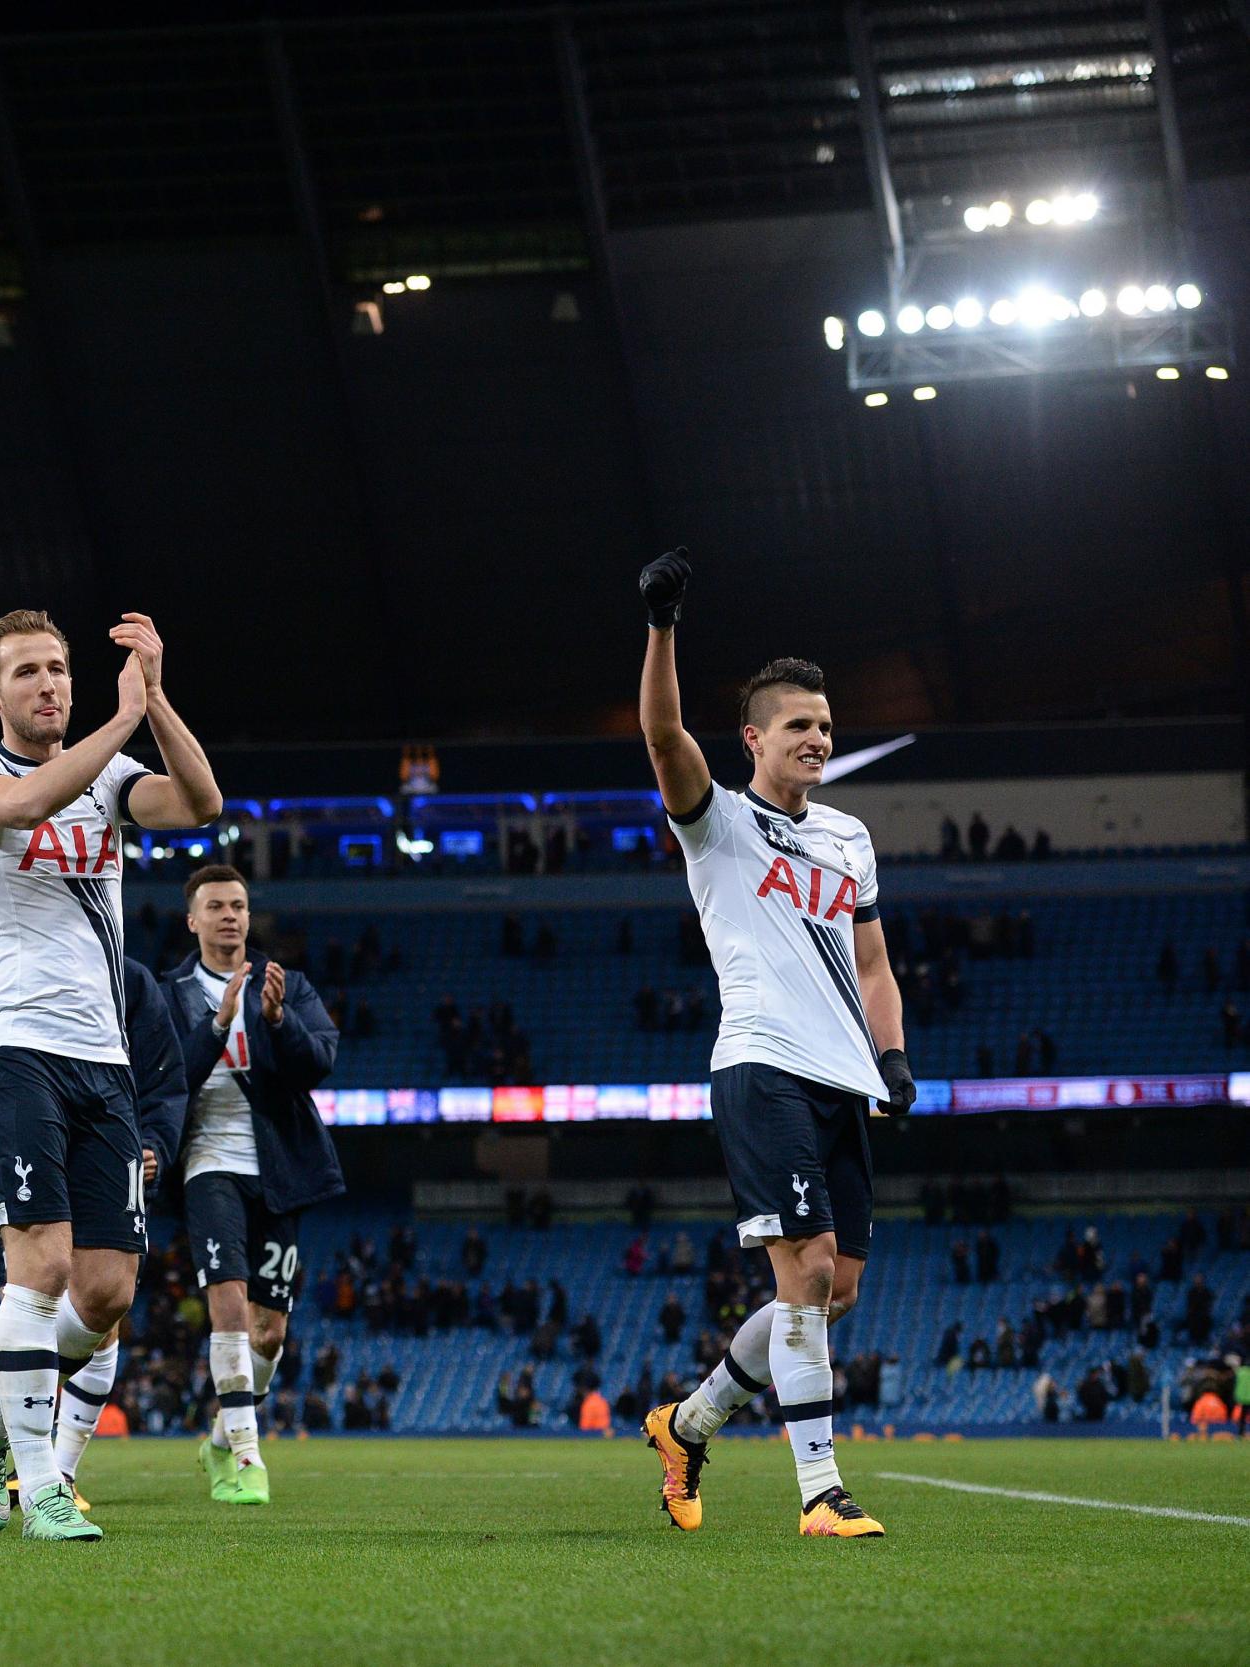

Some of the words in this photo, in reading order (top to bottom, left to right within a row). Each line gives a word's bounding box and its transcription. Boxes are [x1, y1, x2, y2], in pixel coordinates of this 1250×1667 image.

[17, 820, 120, 874] AIA
[756, 856, 857, 922] AIA
[258, 1240, 299, 1283] 20
